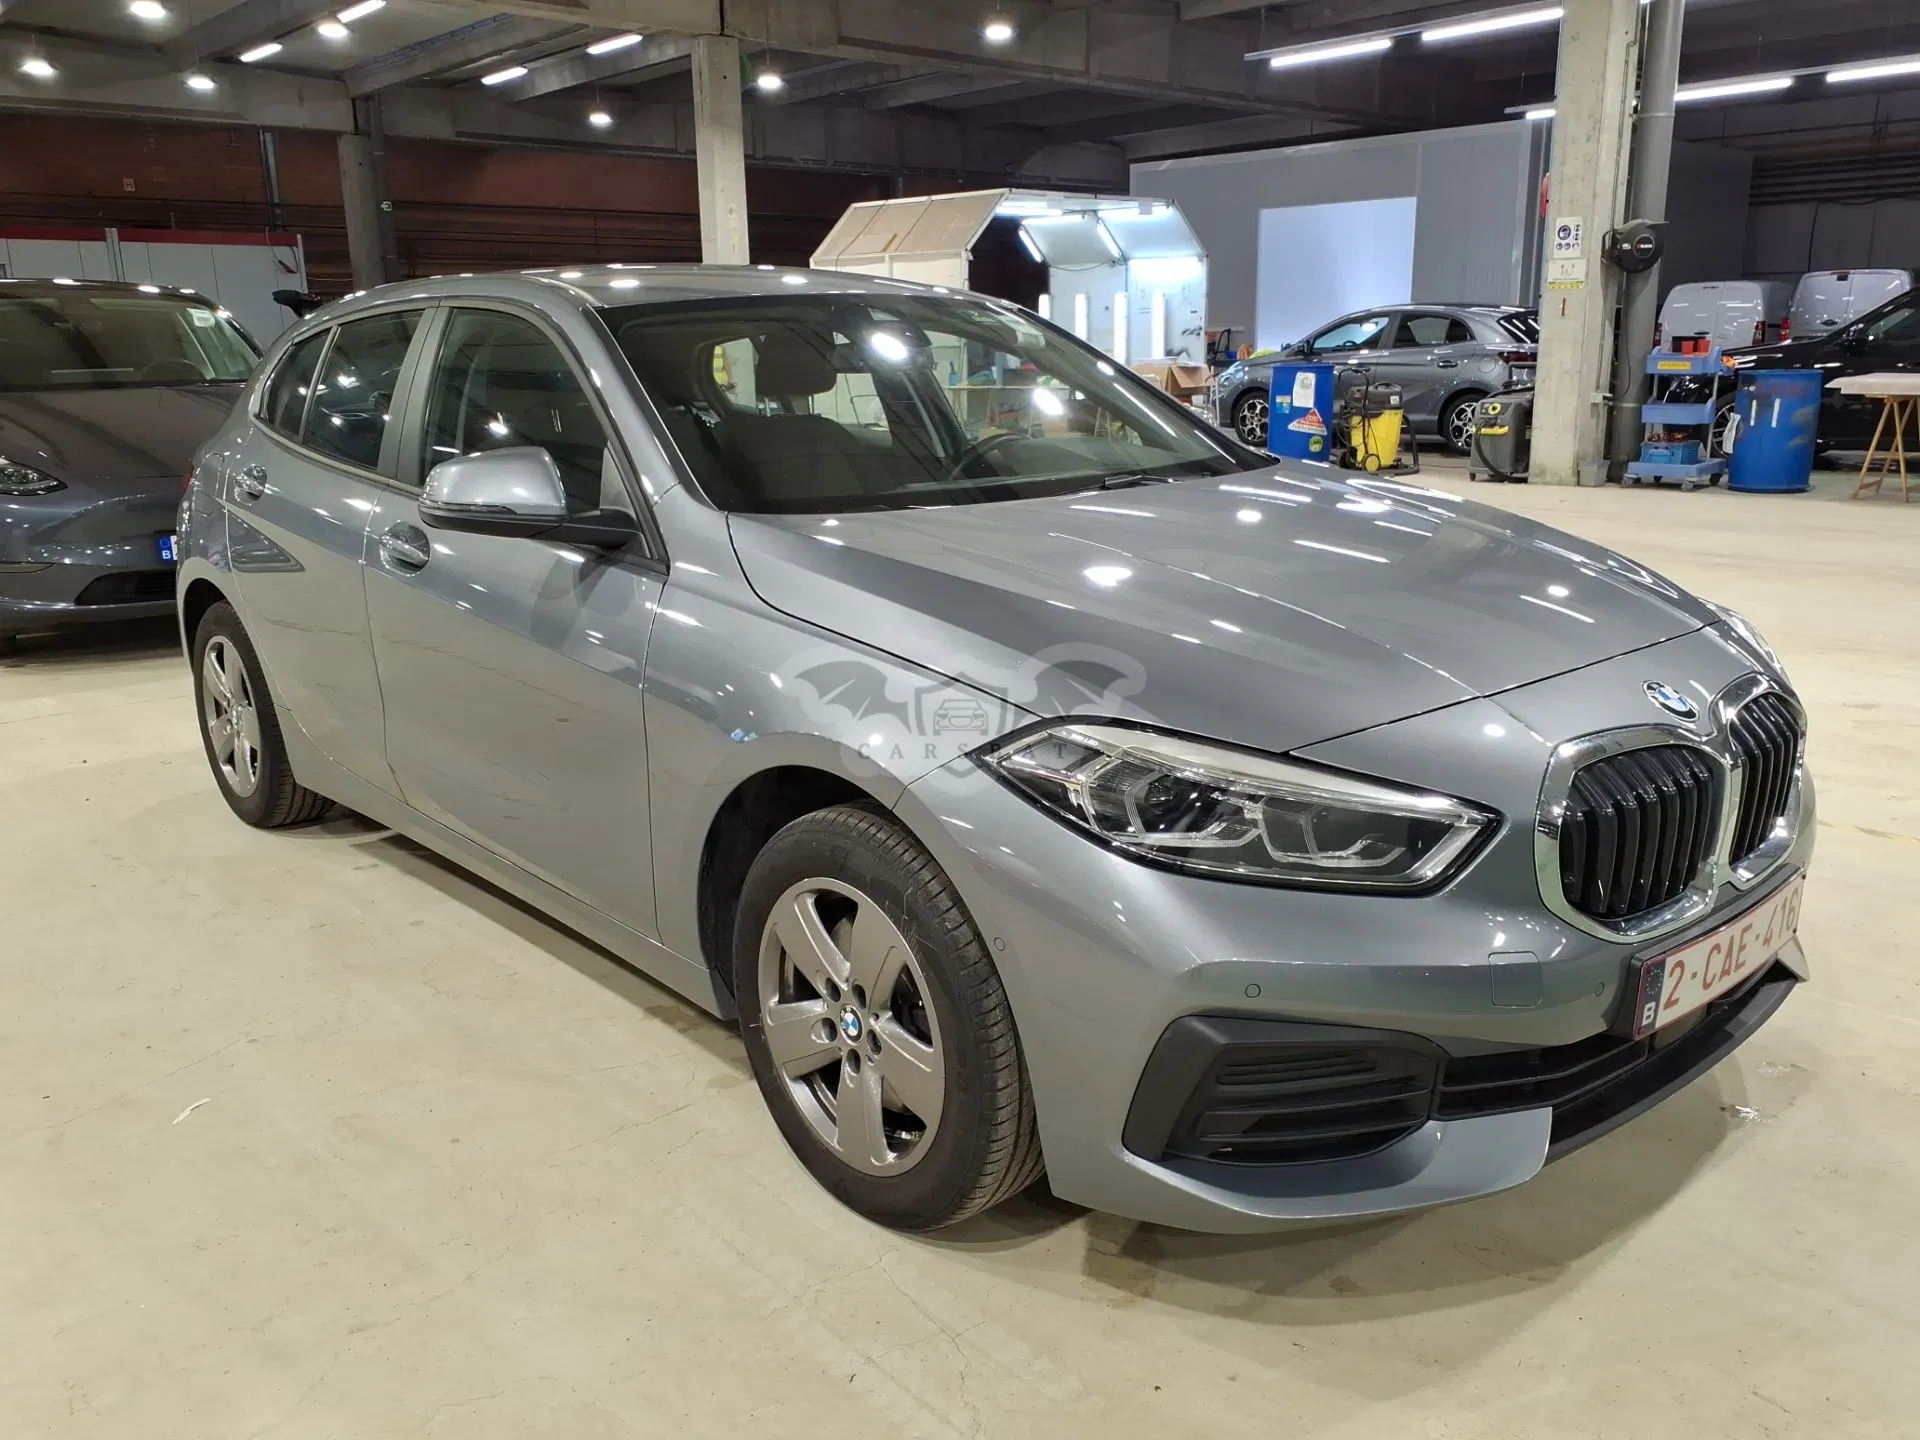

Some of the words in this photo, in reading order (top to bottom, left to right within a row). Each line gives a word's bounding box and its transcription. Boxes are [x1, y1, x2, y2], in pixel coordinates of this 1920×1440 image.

[162, 550, 171, 560] B
[1663, 886, 1799, 1011] 2-CAE-416
[1641, 1002, 1656, 1026] B
